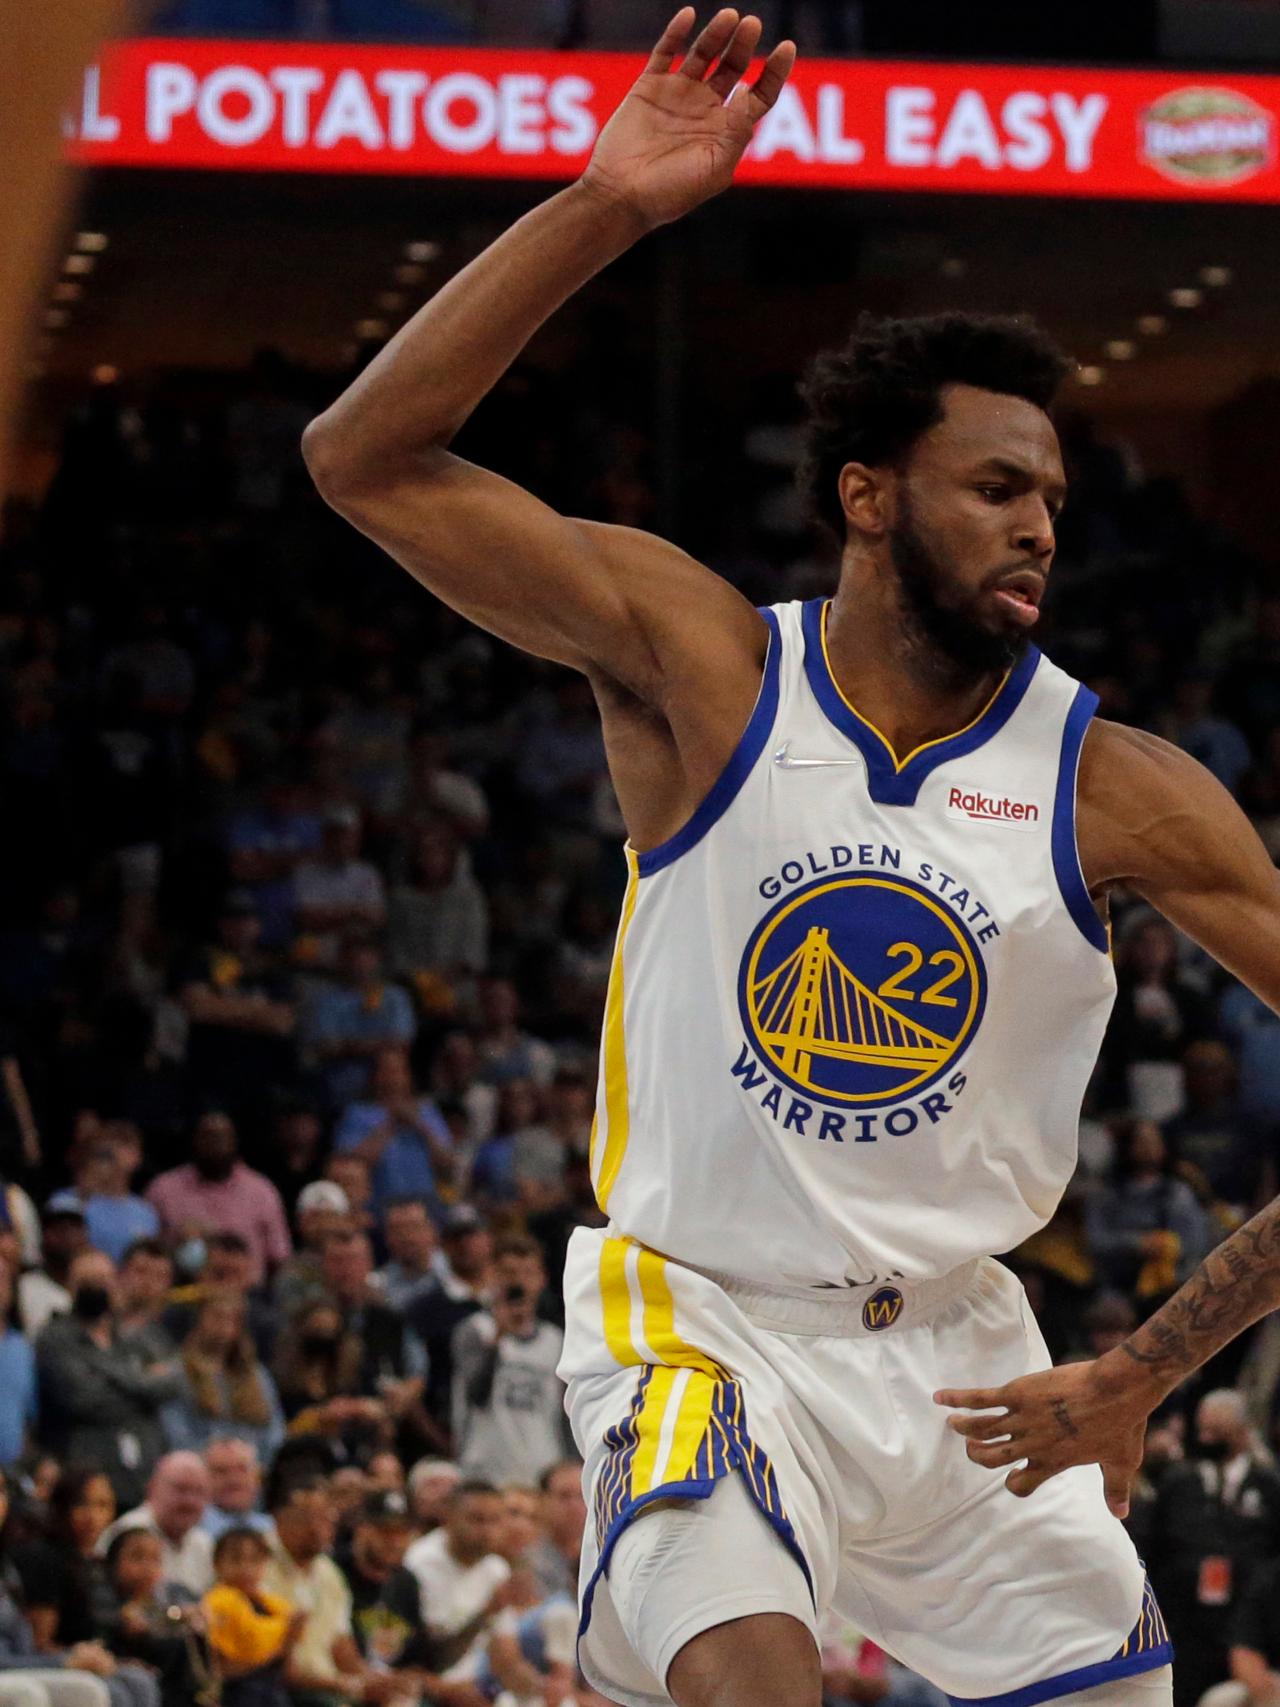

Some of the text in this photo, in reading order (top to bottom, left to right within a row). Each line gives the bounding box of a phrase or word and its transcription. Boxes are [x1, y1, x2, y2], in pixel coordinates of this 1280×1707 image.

[146, 62, 597, 155] POTATOES
[746, 83, 863, 165] AL
[885, 86, 1108, 171] EASY
[948, 787, 1039, 822] Rakuten
[758, 844, 1000, 945] GOLDEN STATE
[878, 941, 966, 1008] 22
[730, 1041, 969, 1143] WARRIORS
